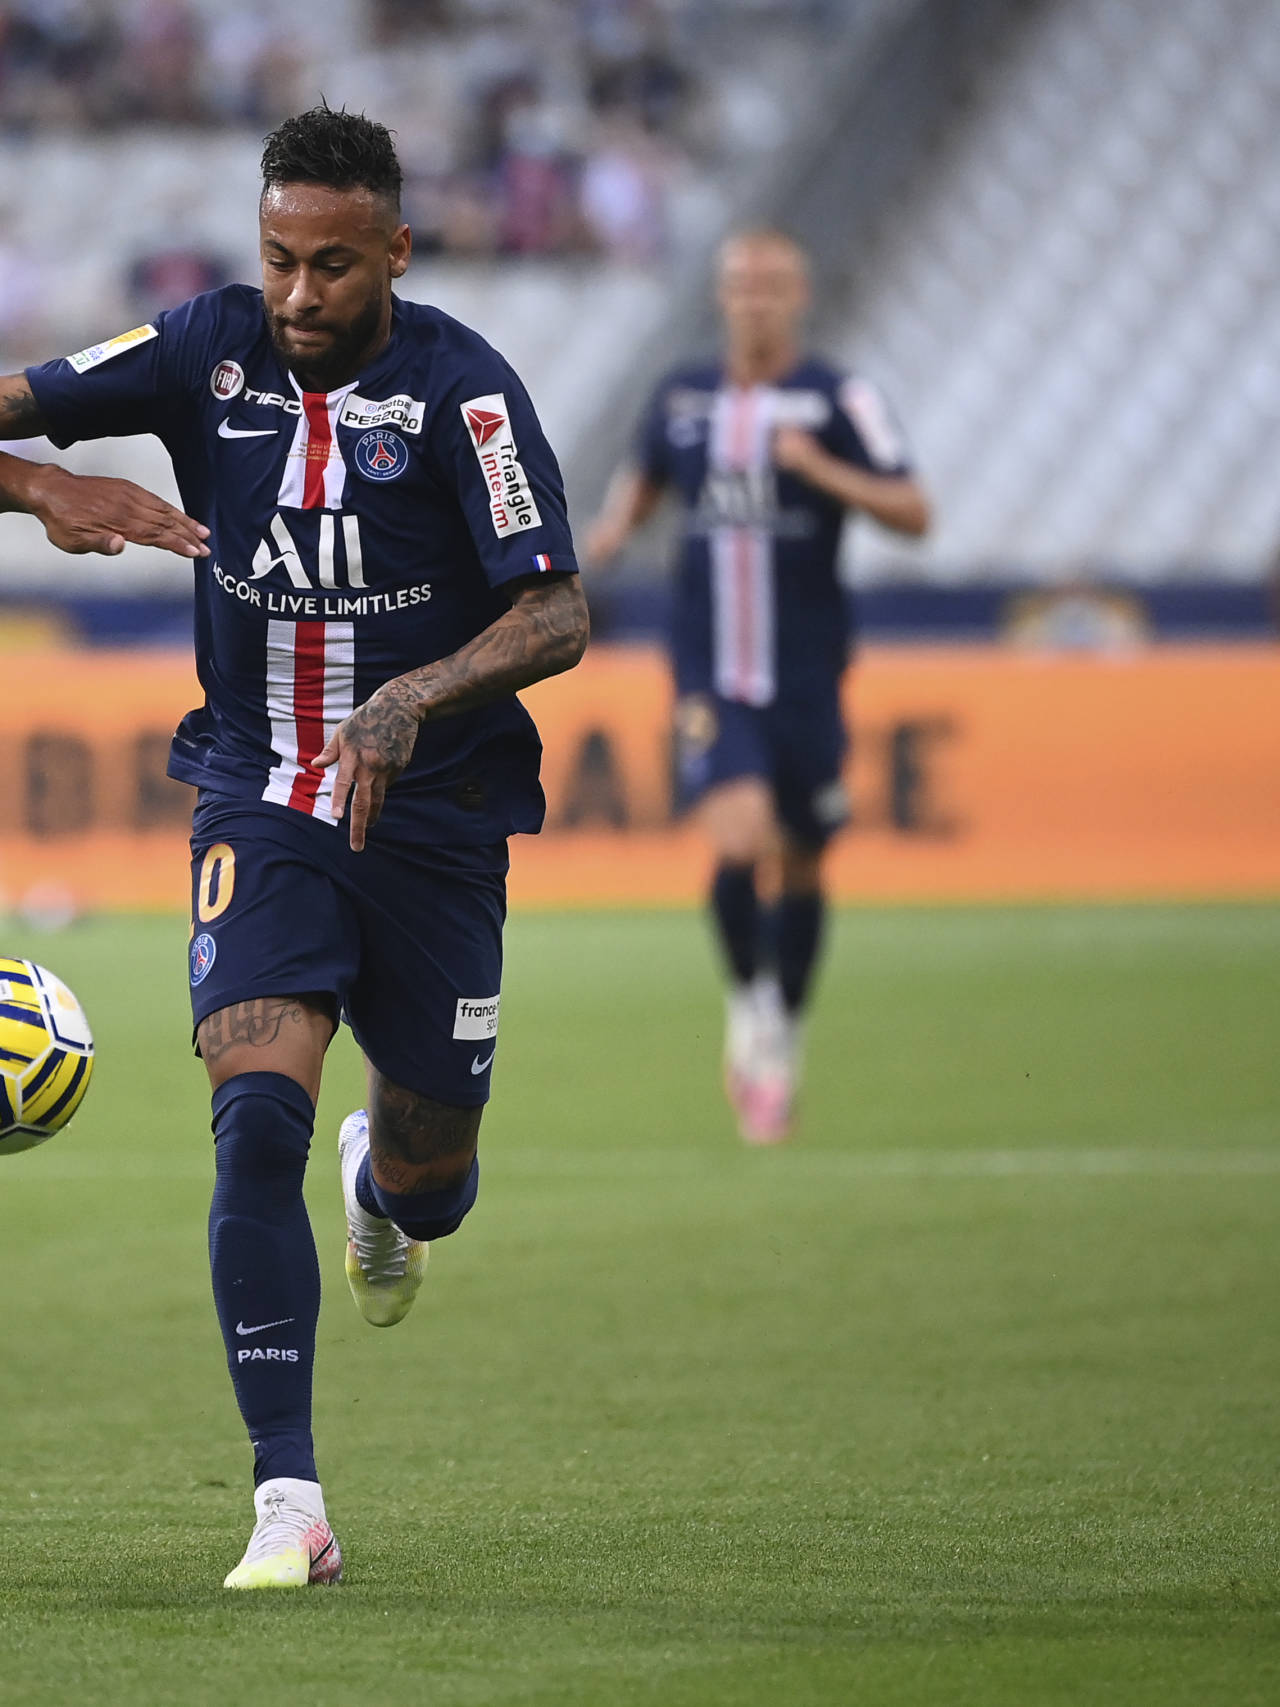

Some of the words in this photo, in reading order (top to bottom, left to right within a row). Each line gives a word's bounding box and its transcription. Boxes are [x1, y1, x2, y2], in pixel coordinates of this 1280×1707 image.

[216, 370, 238, 391] FIAT
[244, 386, 302, 415] TIPO
[362, 432, 397, 447] PARIS
[500, 441, 532, 526] Triangle
[267, 593, 317, 615] LIVE
[324, 584, 432, 615] LIMITLESS
[237, 1347, 300, 1364] PARIS
